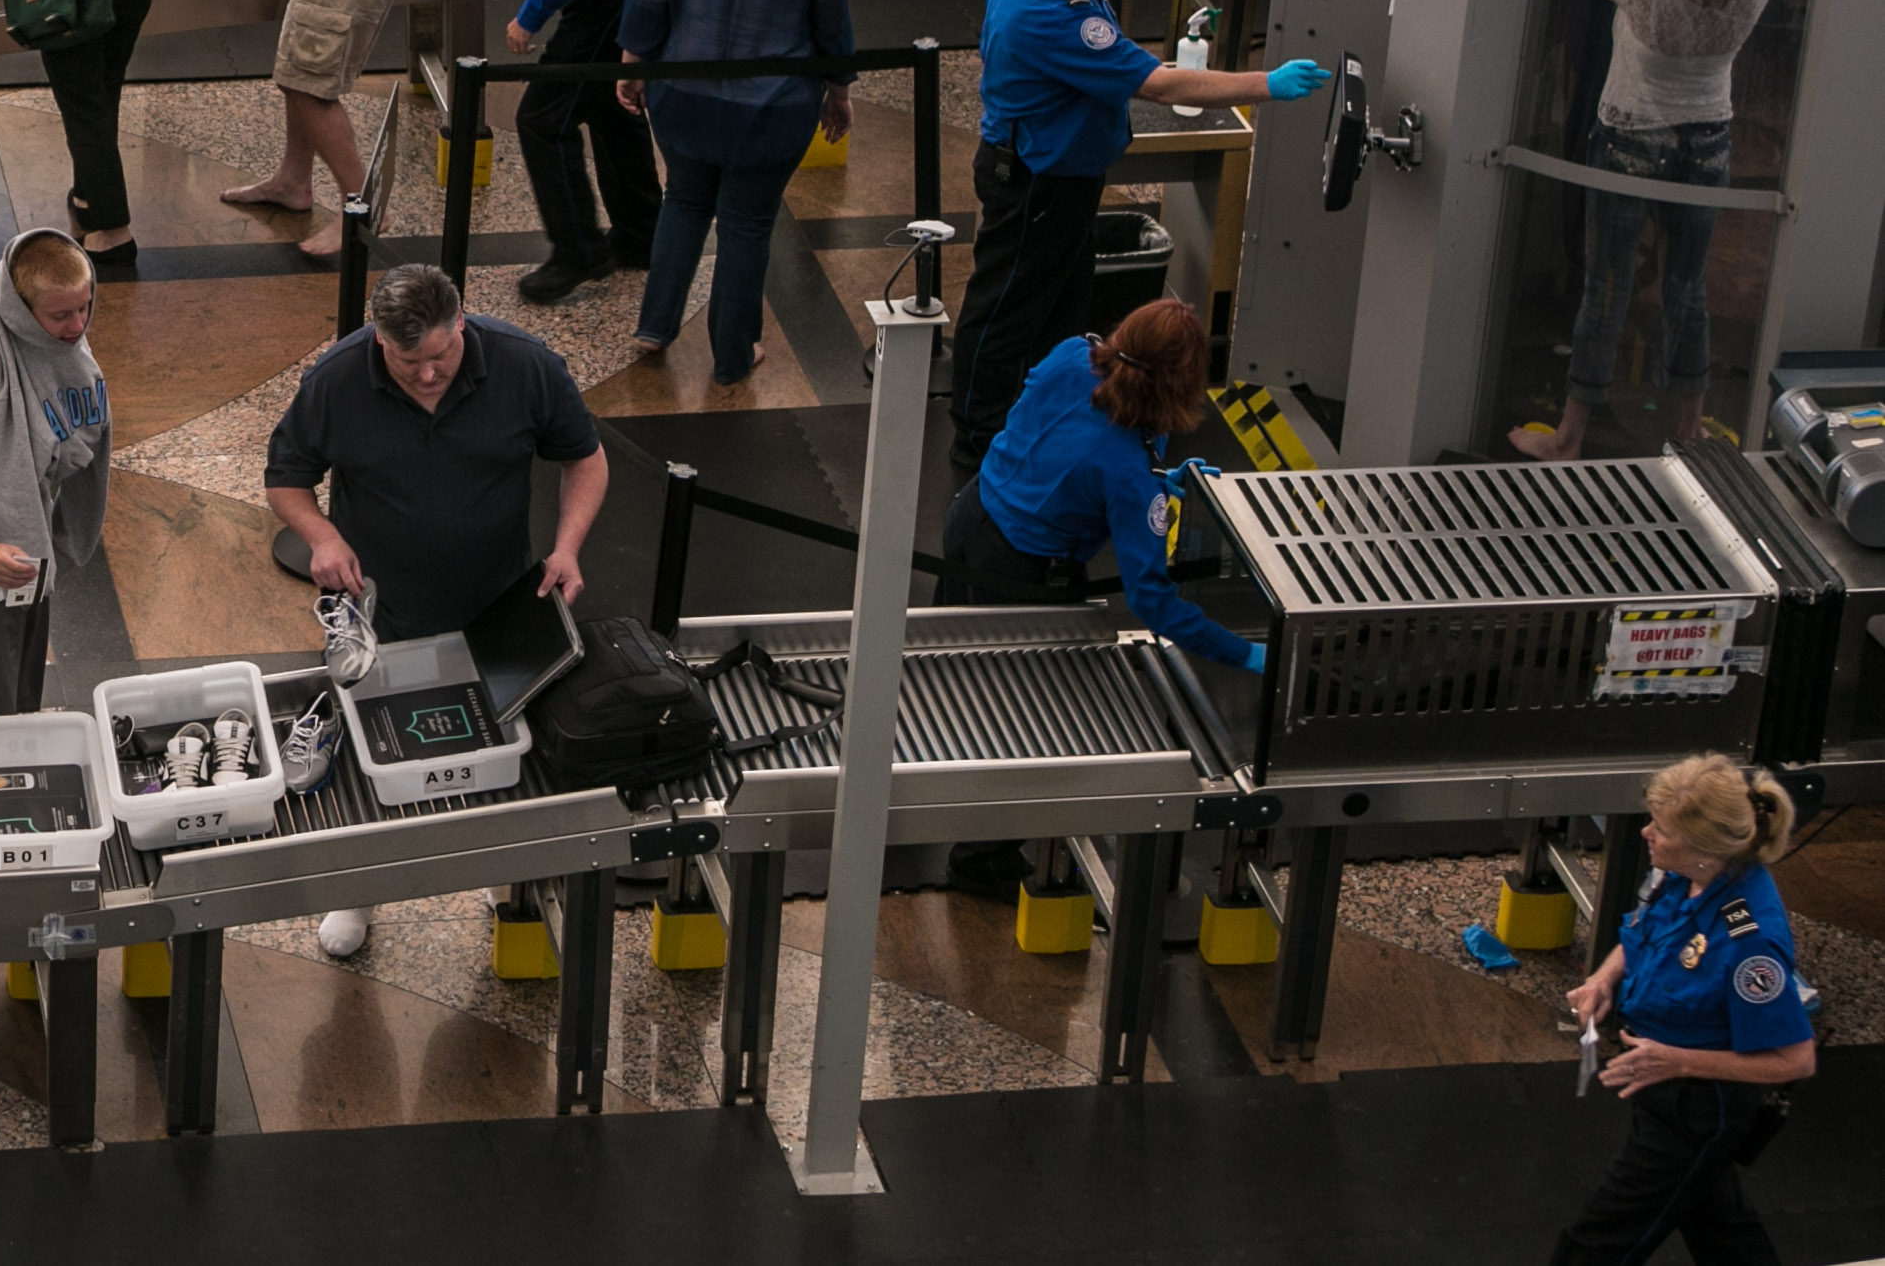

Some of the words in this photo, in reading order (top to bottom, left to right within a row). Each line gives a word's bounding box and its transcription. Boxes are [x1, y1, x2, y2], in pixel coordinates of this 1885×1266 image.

[1630, 628, 1671, 642] HEAVY
[1672, 625, 1707, 639] BAGS
[1635, 650, 1662, 664] GOT
[1664, 648, 1694, 661] HELP
[466, 688, 482, 717] BECAUSE
[477, 717, 488, 731] YOU
[426, 766, 472, 785] A93
[177, 813, 223, 830] C37
[3, 849, 48, 864] B01
[1725, 909, 1750, 923] TSA
